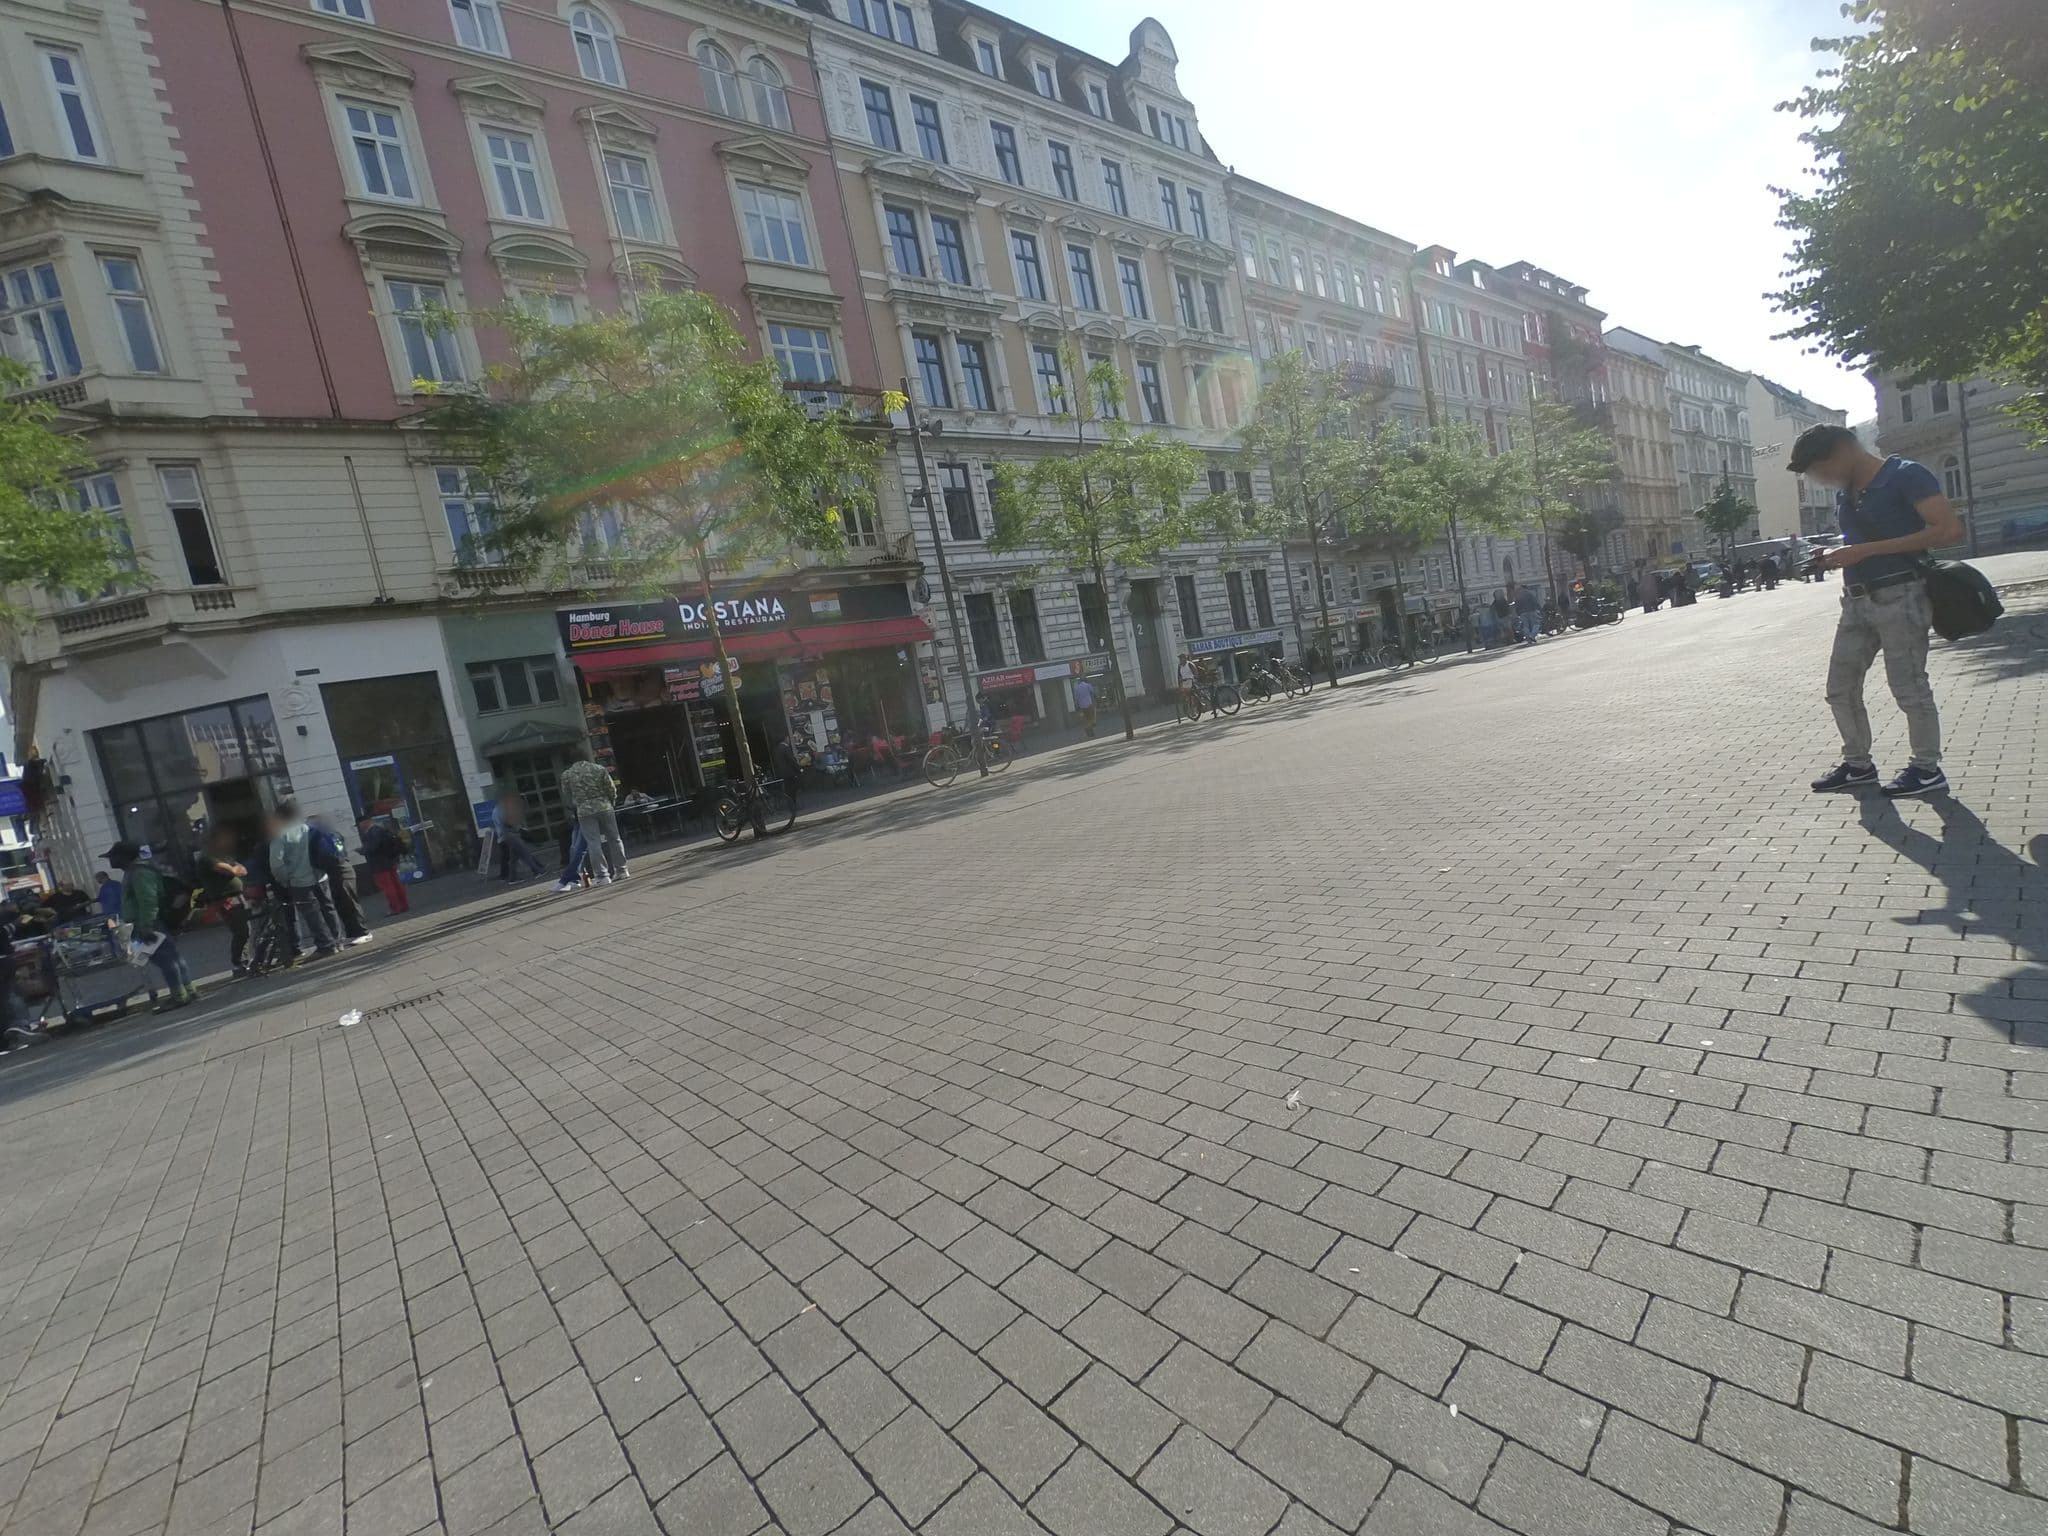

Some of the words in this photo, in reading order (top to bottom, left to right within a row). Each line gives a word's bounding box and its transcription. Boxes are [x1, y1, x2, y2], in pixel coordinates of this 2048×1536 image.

[679, 597, 785, 623] DOSTANA
[569, 612, 610, 624] Hamburg
[724, 613, 787, 627] RESTAURANT
[570, 621, 616, 641] Döner
[619, 619, 664, 636] House
[1137, 624, 1144, 635] 2
